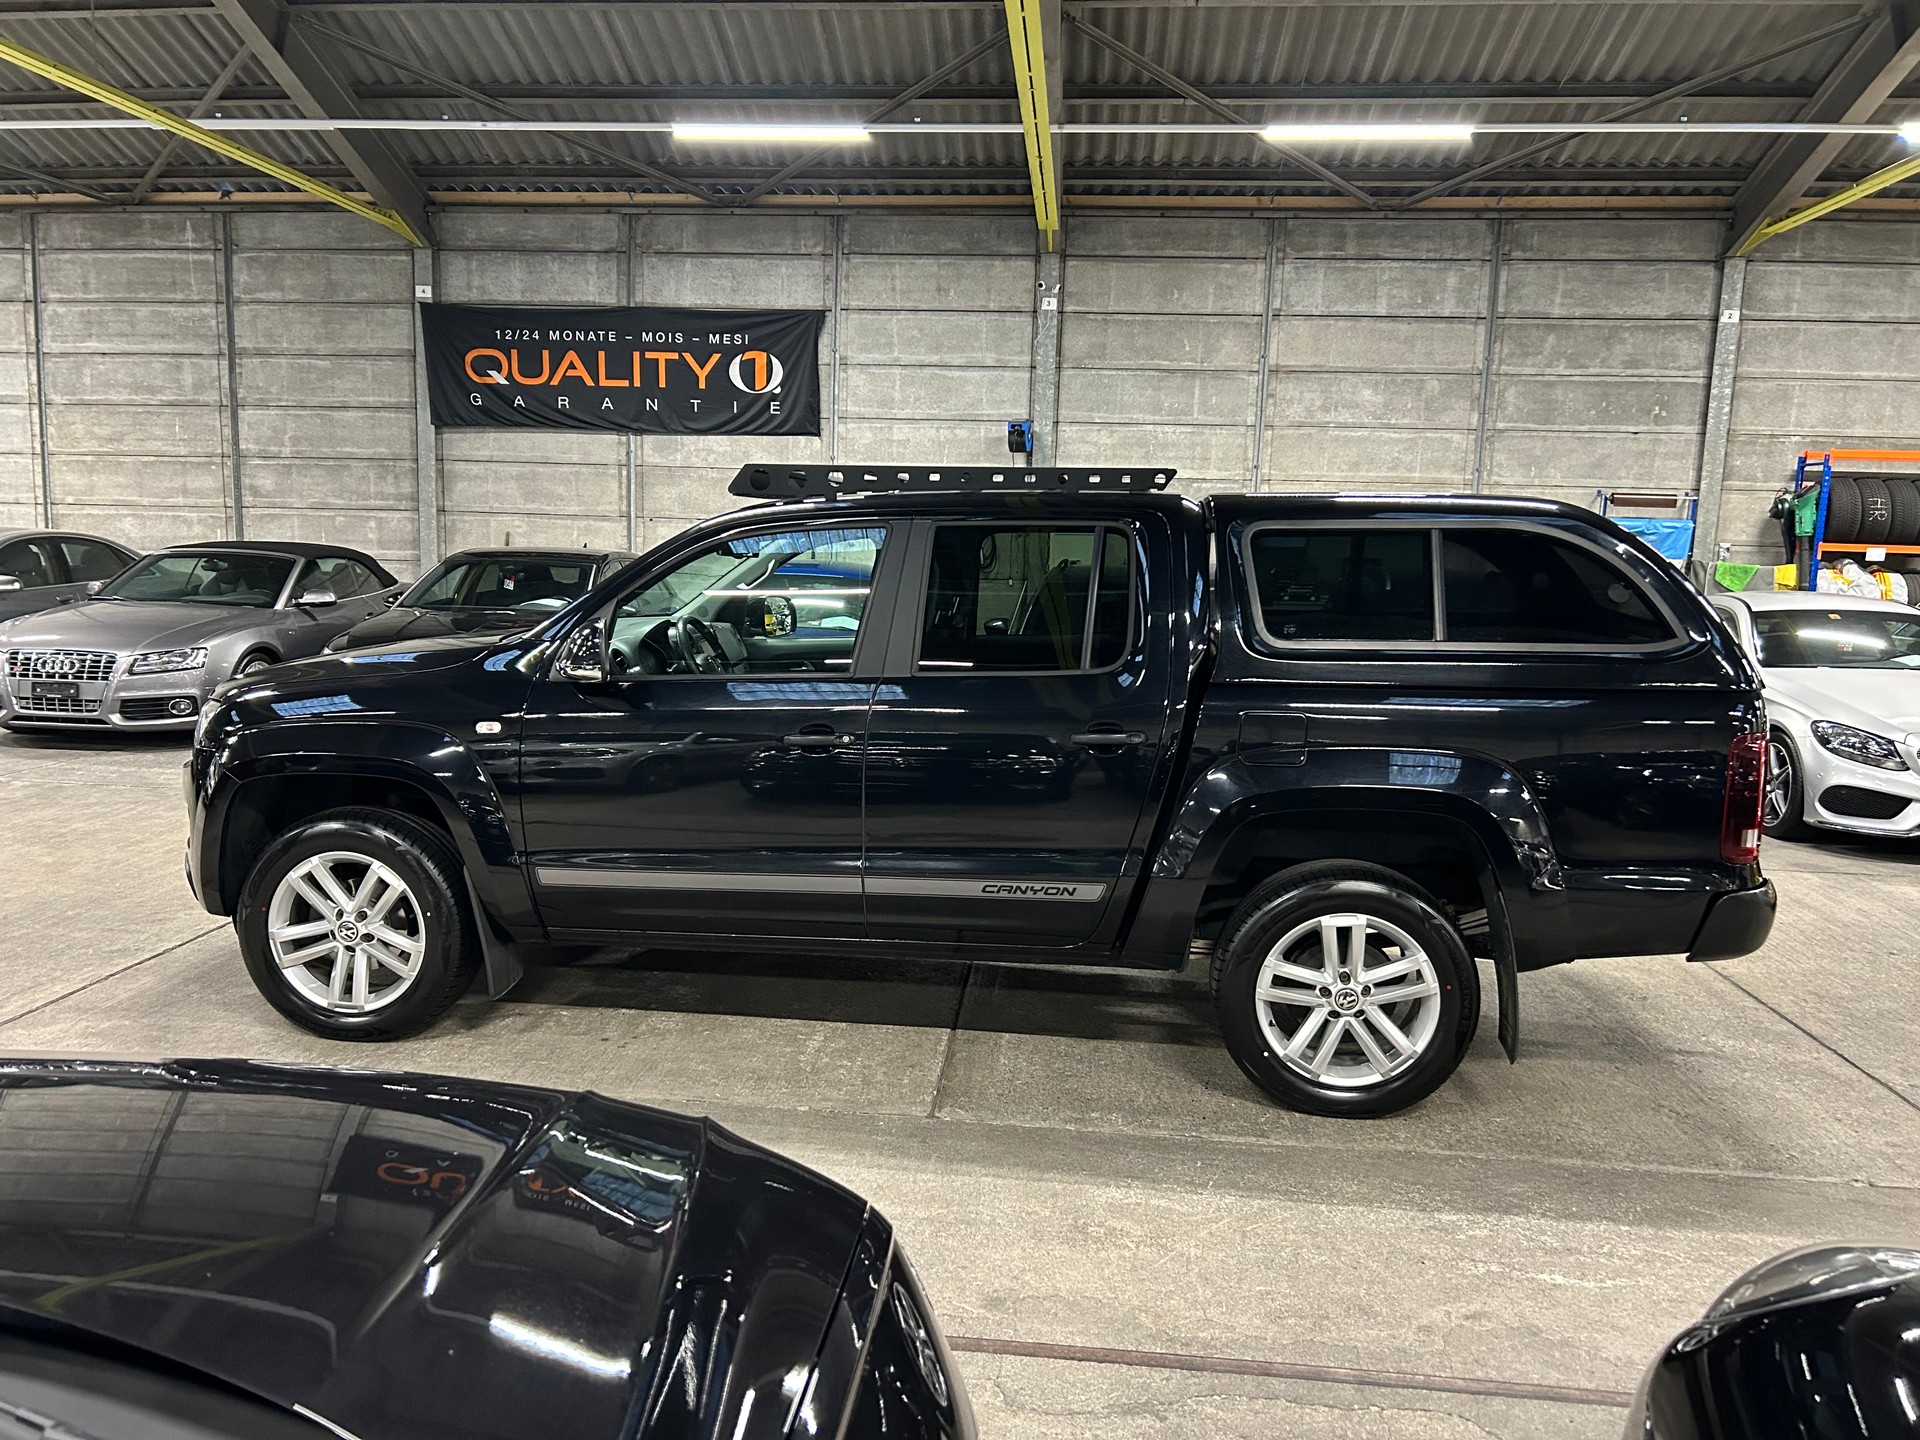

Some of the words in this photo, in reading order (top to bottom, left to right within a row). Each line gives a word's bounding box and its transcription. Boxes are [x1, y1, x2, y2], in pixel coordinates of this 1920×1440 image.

[494, 329, 540, 341] 12/24
[549, 330, 617, 342] MONATE
[641, 331, 684, 343] MOIS
[708, 333, 749, 345] MESI
[464, 347, 722, 390] QUALITY
[469, 393, 781, 415] GARANTIE
[981, 884, 1078, 897] CANYON
